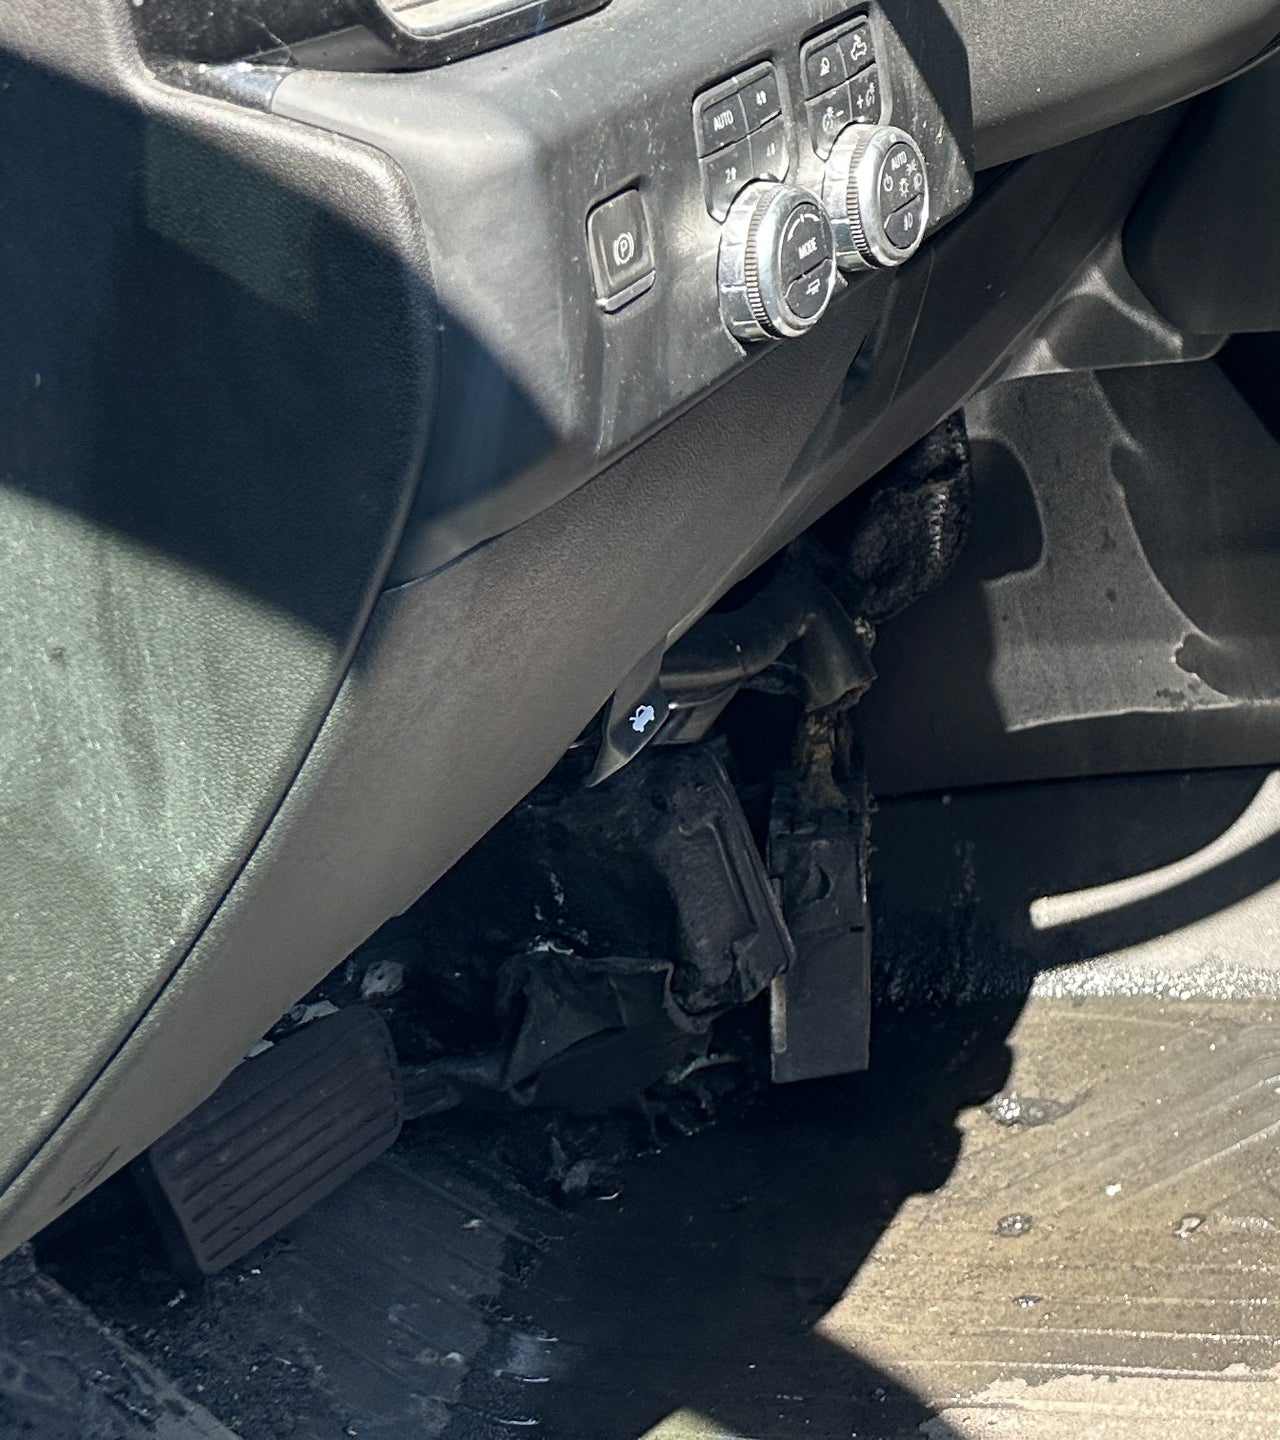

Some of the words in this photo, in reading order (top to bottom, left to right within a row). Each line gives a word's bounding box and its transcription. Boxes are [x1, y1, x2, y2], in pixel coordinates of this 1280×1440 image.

[713, 110, 734, 132] AUTO
[891, 151, 908, 171] AUTO
[798, 236, 818, 259] MODE
